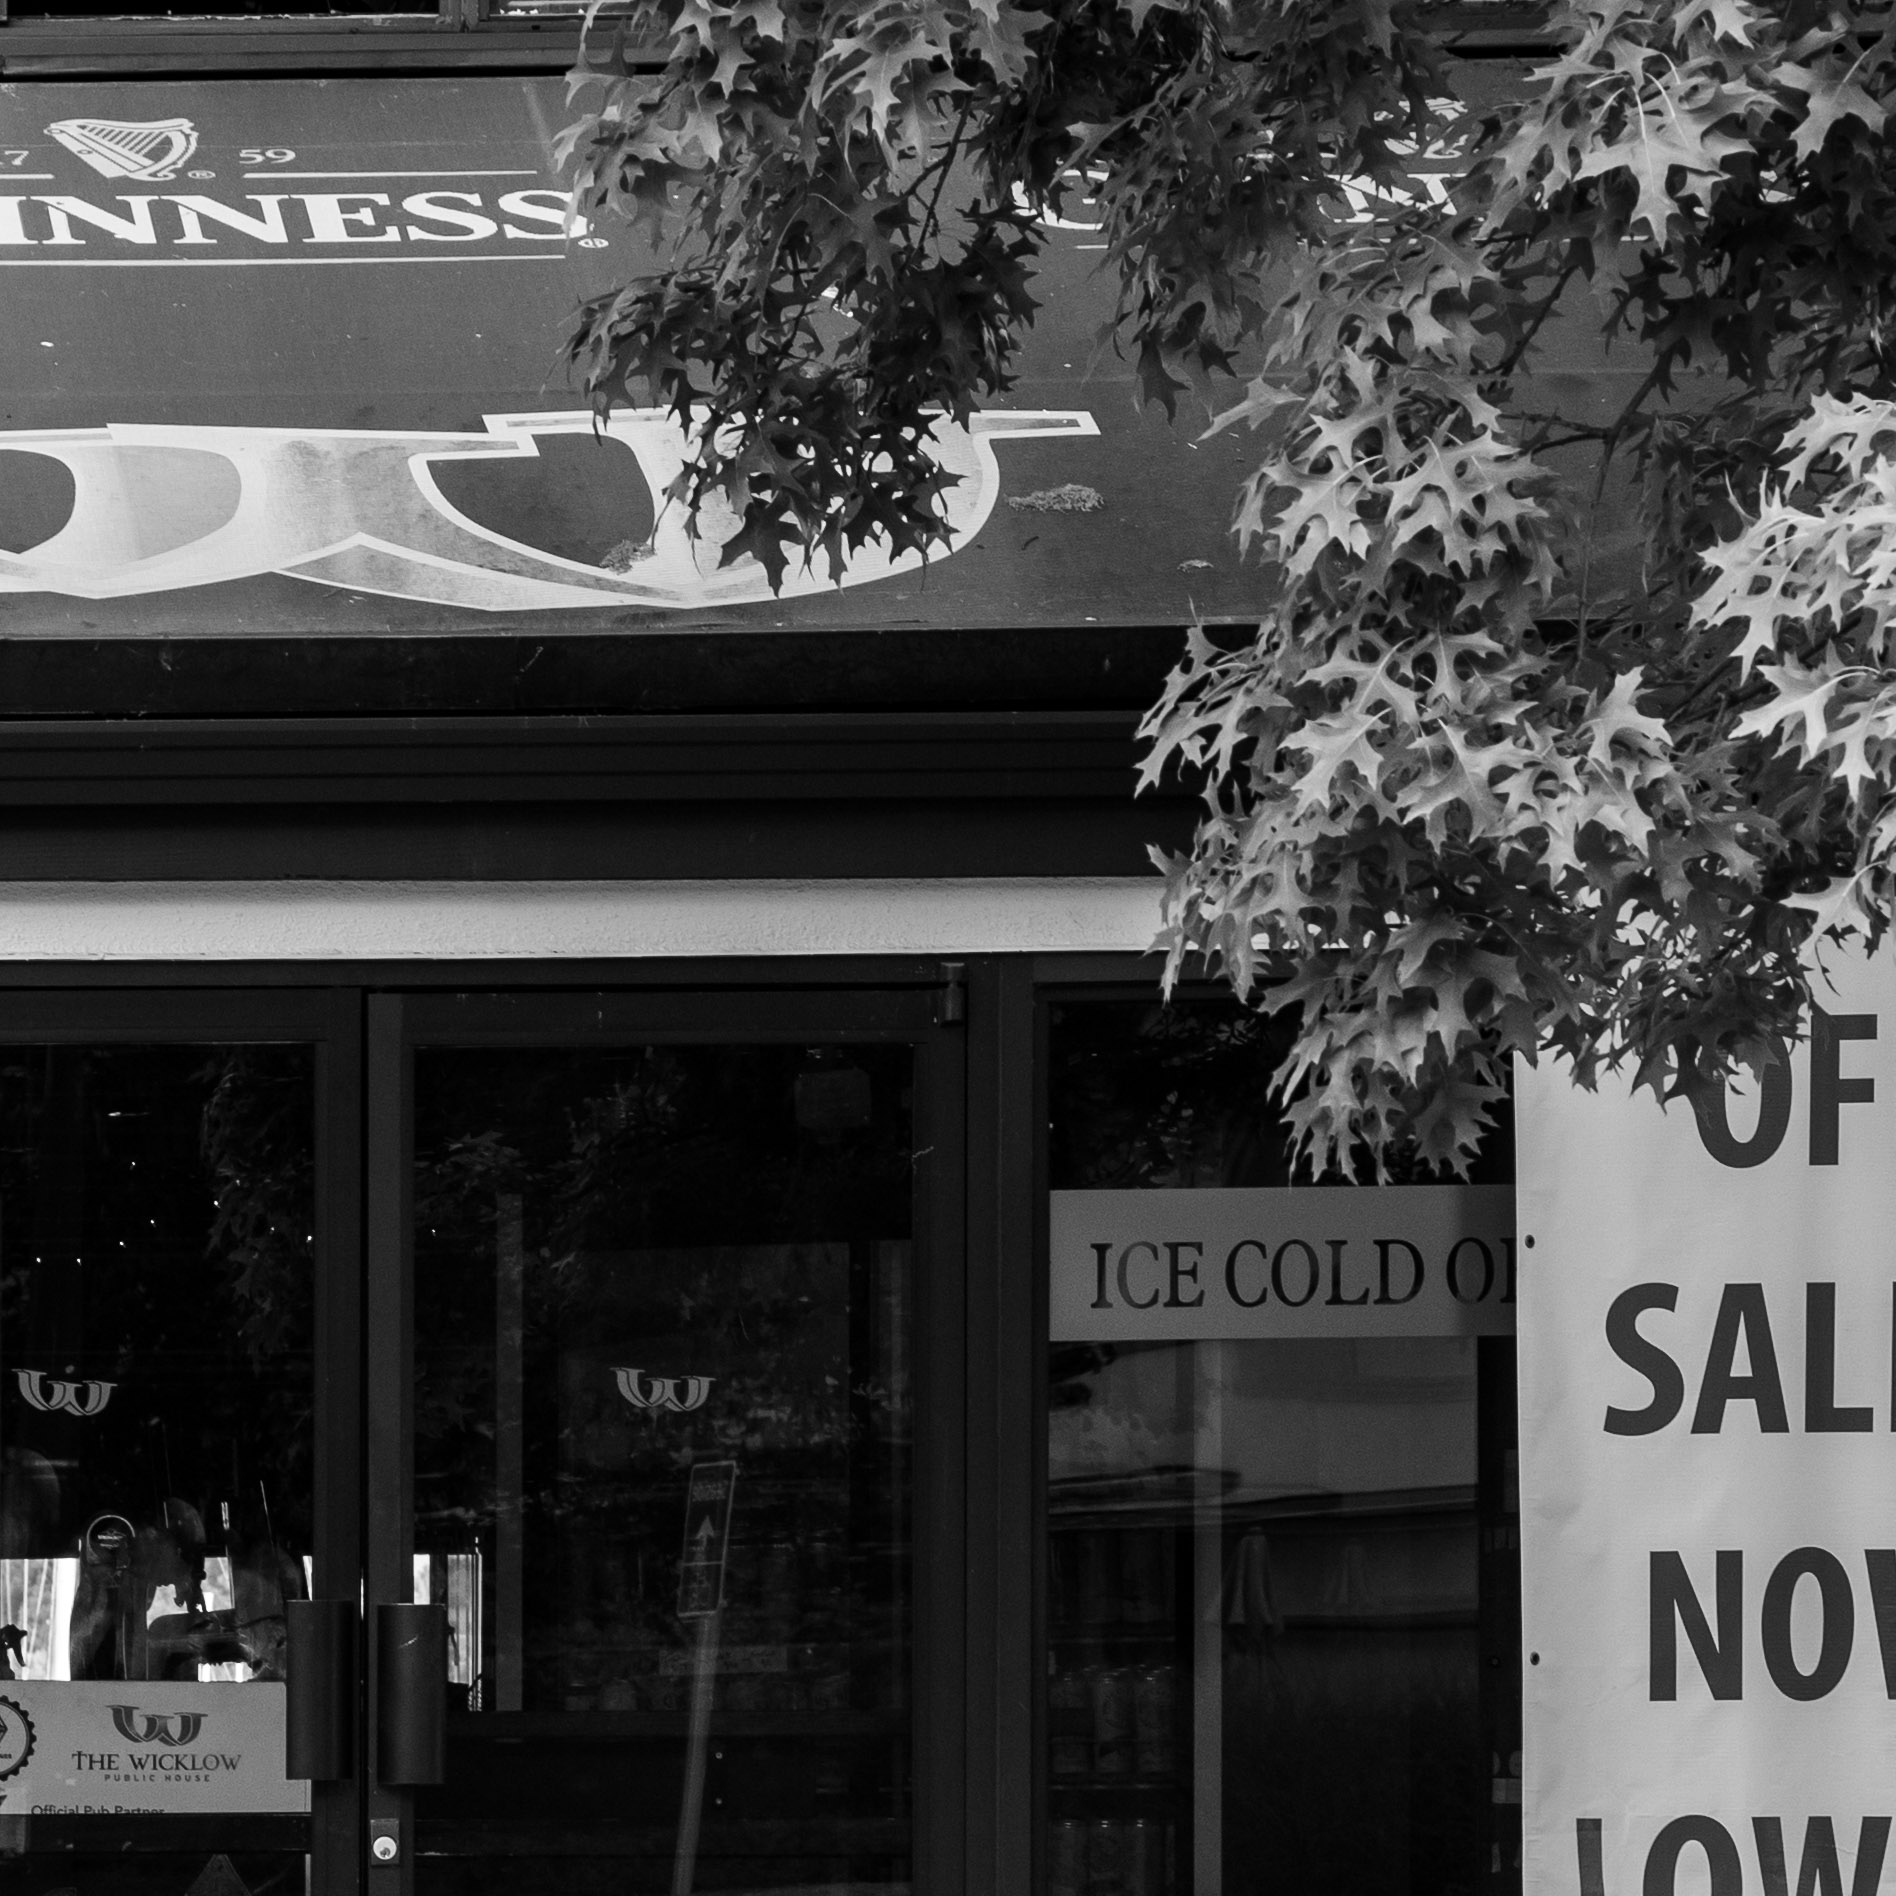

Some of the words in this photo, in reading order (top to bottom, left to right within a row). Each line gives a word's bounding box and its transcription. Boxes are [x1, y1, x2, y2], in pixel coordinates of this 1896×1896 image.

[238, 147, 297, 166] 59
[1088, 1239, 1206, 1311] ICE
[1224, 1237, 1426, 1309] COLD
[70, 1749, 121, 1772] THE
[127, 1752, 243, 1772] WICKLOW
[103, 1772, 157, 1784] PUBLIC
[163, 1772, 211, 1784] HOUSE
